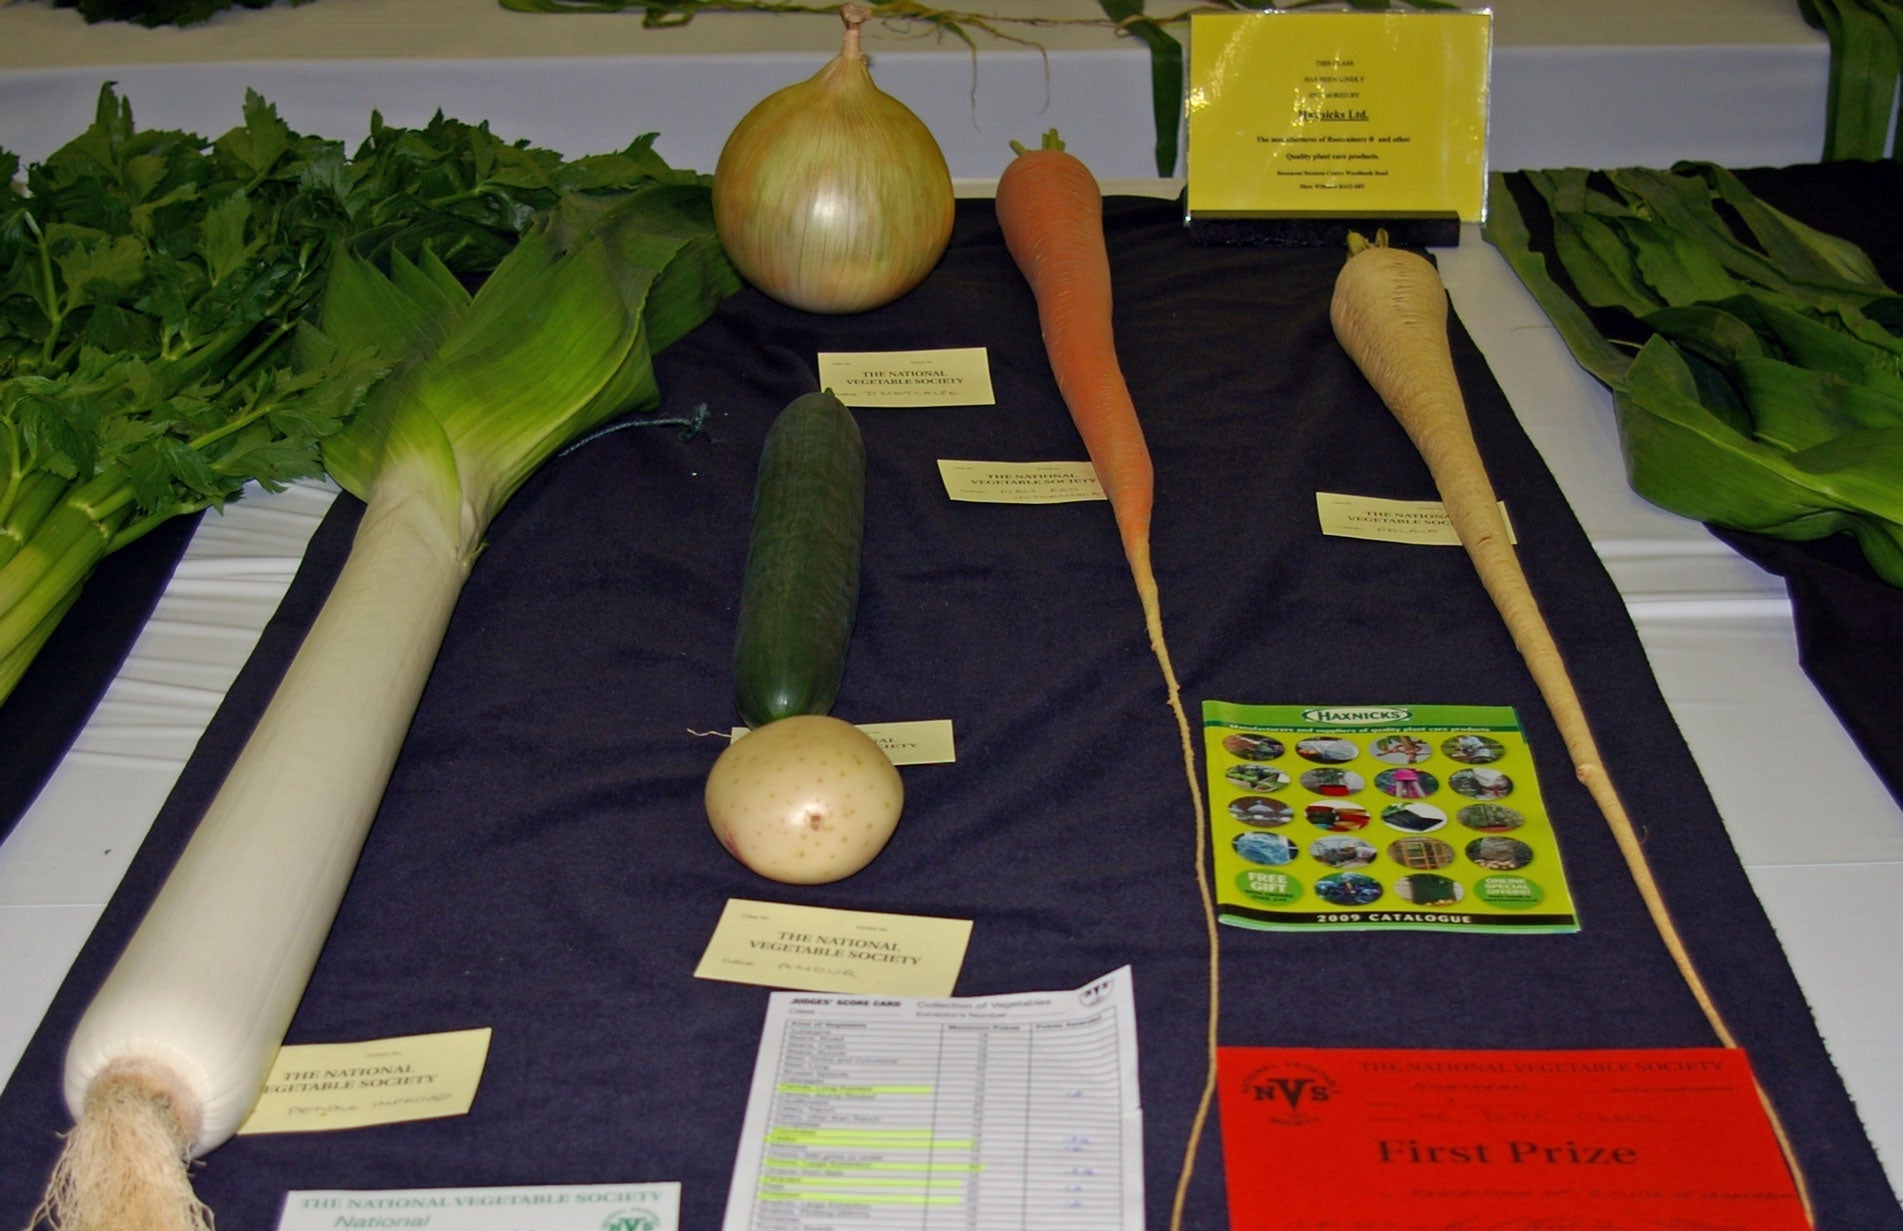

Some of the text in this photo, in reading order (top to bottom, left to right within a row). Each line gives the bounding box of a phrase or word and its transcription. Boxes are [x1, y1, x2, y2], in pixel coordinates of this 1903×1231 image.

[1286, 153, 1311, 161] Quality
[1313, 153, 1331, 161] plant
[863, 370, 948, 378] THE NATIONAL
[846, 377, 964, 386] VEGETABLE SOCIETY
[1348, 516, 1423, 525] VEGETABLE
[1317, 709, 1400, 721] HAXNICKS
[1248, 872, 1287, 883] FREE
[1250, 881, 1287, 893] GIFT
[1316, 913, 1472, 923] 2009 CATALOGUE
[778, 931, 900, 951] THE NATIONAL
[749, 940, 922, 966] VEGETABLE SOCIETY
[917, 1000, 1052, 1009] Collection of Vegetables
[1360, 1060, 1724, 1073] THE NATIONAL VEGETABLE SOCIETY
[283, 1064, 415, 1082] THE NATIONAL
[262, 1073, 438, 1094] EGETABLE SOCIETY
[1254, 1078, 1329, 1109] NVS
[1377, 1138, 1639, 1165] First Prize
[302, 1190, 662, 1210] THE NATIONAL VEGETABLE SOCIETY
[332, 1214, 431, 1229] National
